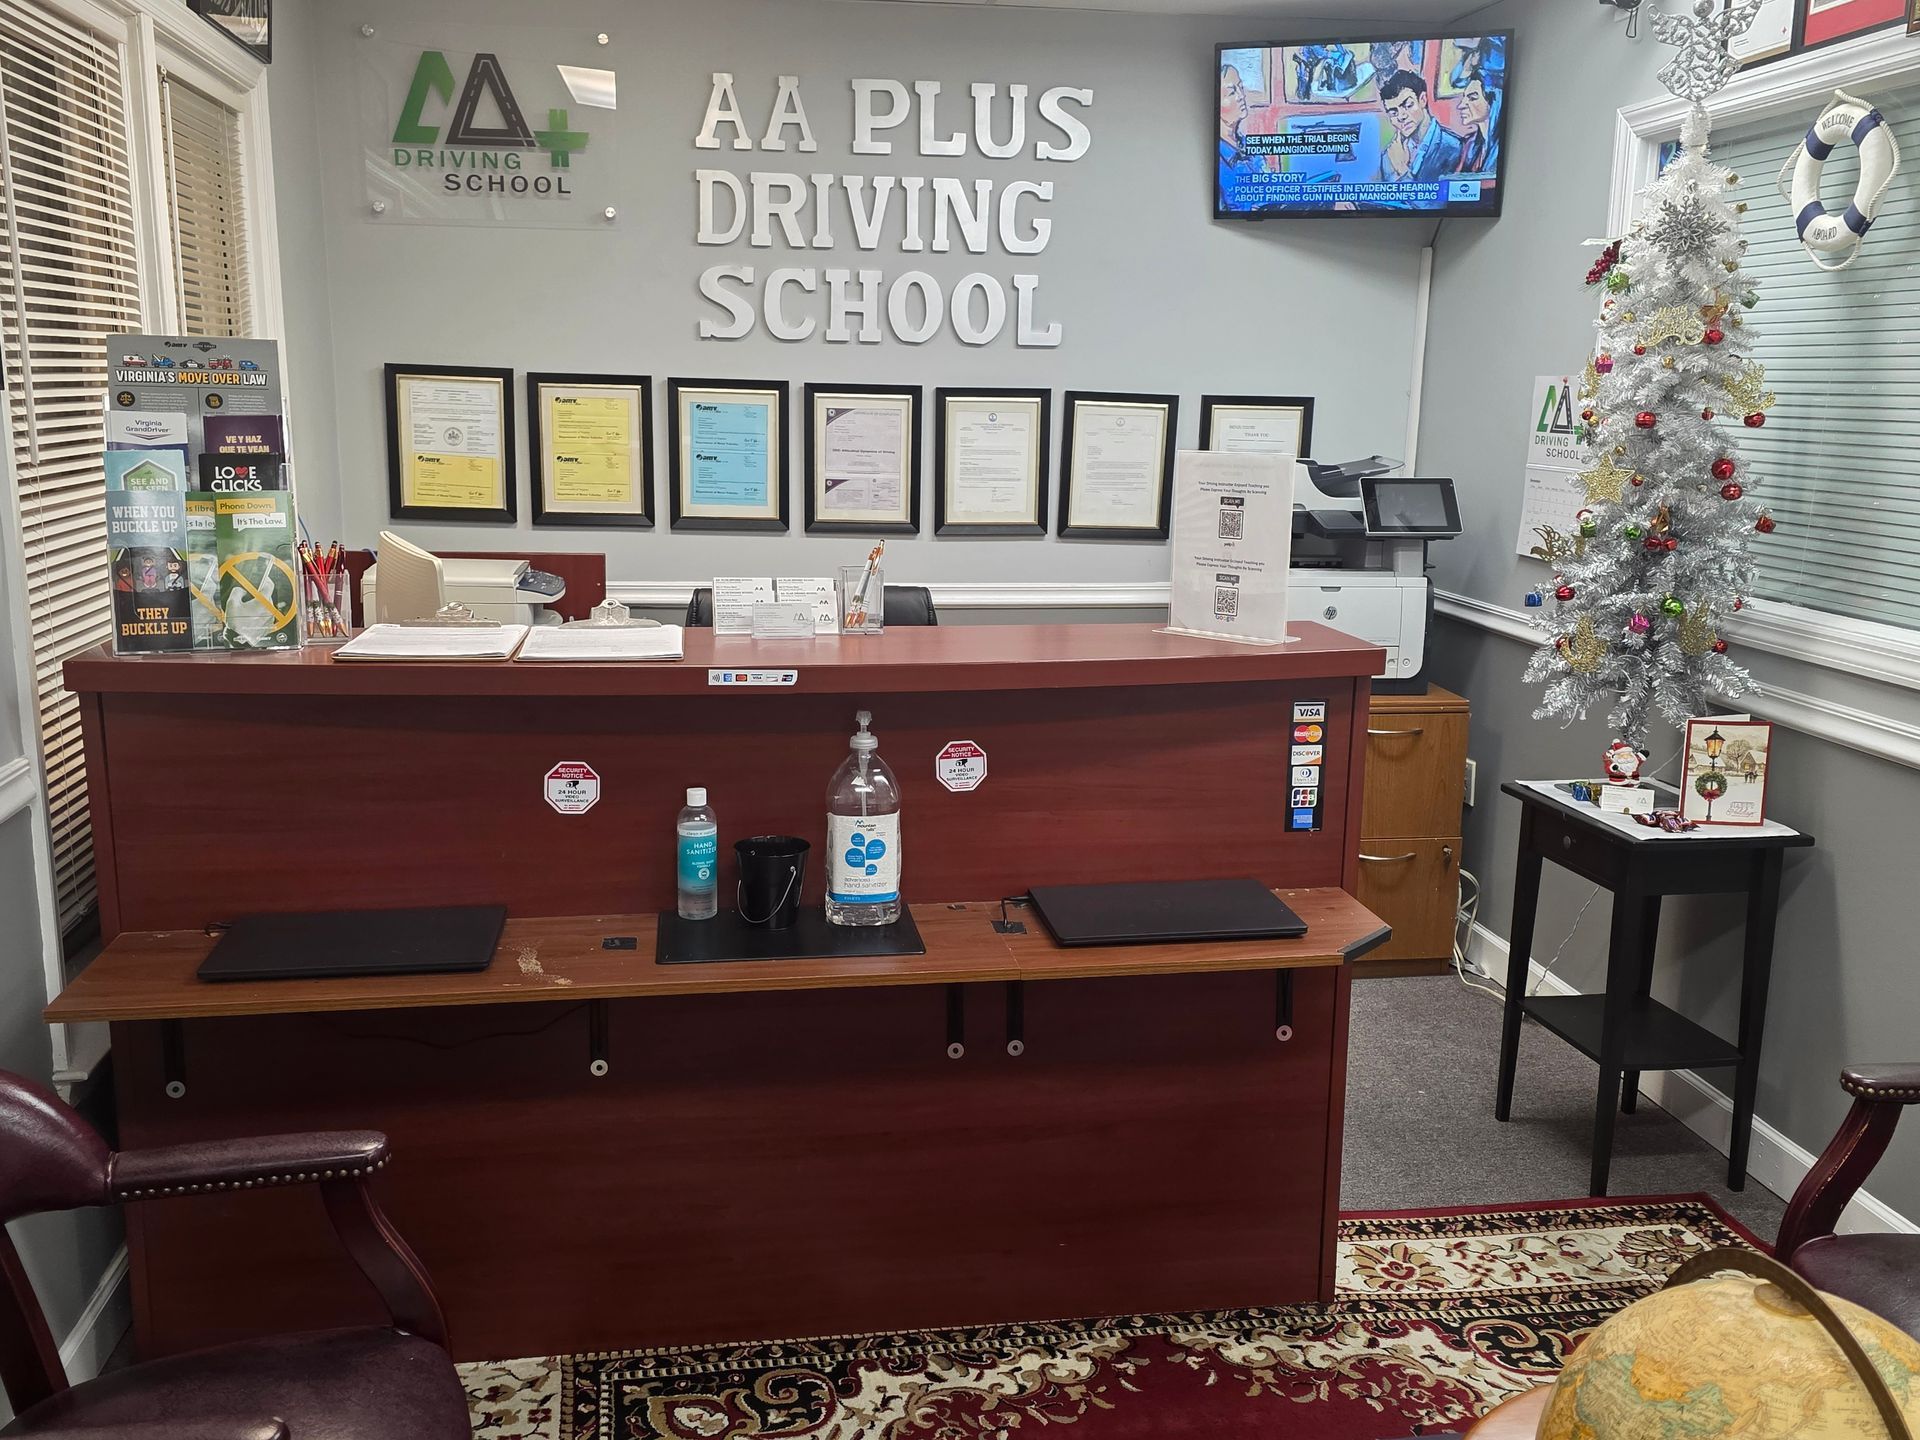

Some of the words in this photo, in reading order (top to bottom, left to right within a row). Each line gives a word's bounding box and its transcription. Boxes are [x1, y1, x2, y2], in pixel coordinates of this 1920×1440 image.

[852, 78, 1093, 161] PLUS
[1821, 114, 1855, 130] WELCOME
[1262, 136, 1285, 144] WHEN
[1304, 135, 1326, 143] TRIAL
[1327, 134, 1358, 142] BEGINS.
[1247, 147, 1272, 155] TODAY,
[1273, 145, 1315, 154] MANGIONE
[1317, 145, 1349, 153] COMING
[394, 149, 521, 170] DRIVING
[444, 174, 571, 194] SCHOOL
[1235, 175, 1250, 183] THE
[1252, 175, 1269, 183] BIG
[1272, 174, 1304, 182] STORY
[1266, 185, 1300, 193] OFFICER
[1355, 184, 1398, 192] EVIDENCE
[1400, 183, 1439, 191] HEARING
[696, 169, 1054, 254] DRIVING
[1812, 226, 1837, 241] ABOARD
[699, 265, 1062, 347] SCHOOL
[115, 370, 176, 384] VIRGINIA'S
[178, 372, 209, 384] MOVE
[212, 373, 240, 385] OVER
[243, 374, 267, 386] LAW
[245, 435, 262, 443] HAZ
[1535, 435, 1568, 447] DRIVING
[247, 445, 269, 453] VEAN
[1546, 448, 1580, 460] SCHOOL
[211, 480, 262, 492] CLICKS
[112, 506, 149, 518] WHEN
[152, 506, 175, 518] YOU
[112, 521, 161, 533] BUCKLE
[163, 521, 178, 533] UP
[237, 518, 247, 526] It's
[137, 608, 169, 620] THEY
[1325, 607, 1336, 619] hp
[122, 623, 168, 636] BUCKLE
[172, 622, 187, 634] UP
[1299, 708, 1321, 716] VISA
[686, 847, 716, 855] SANITIZE
[694, 841, 713, 849] HAND
